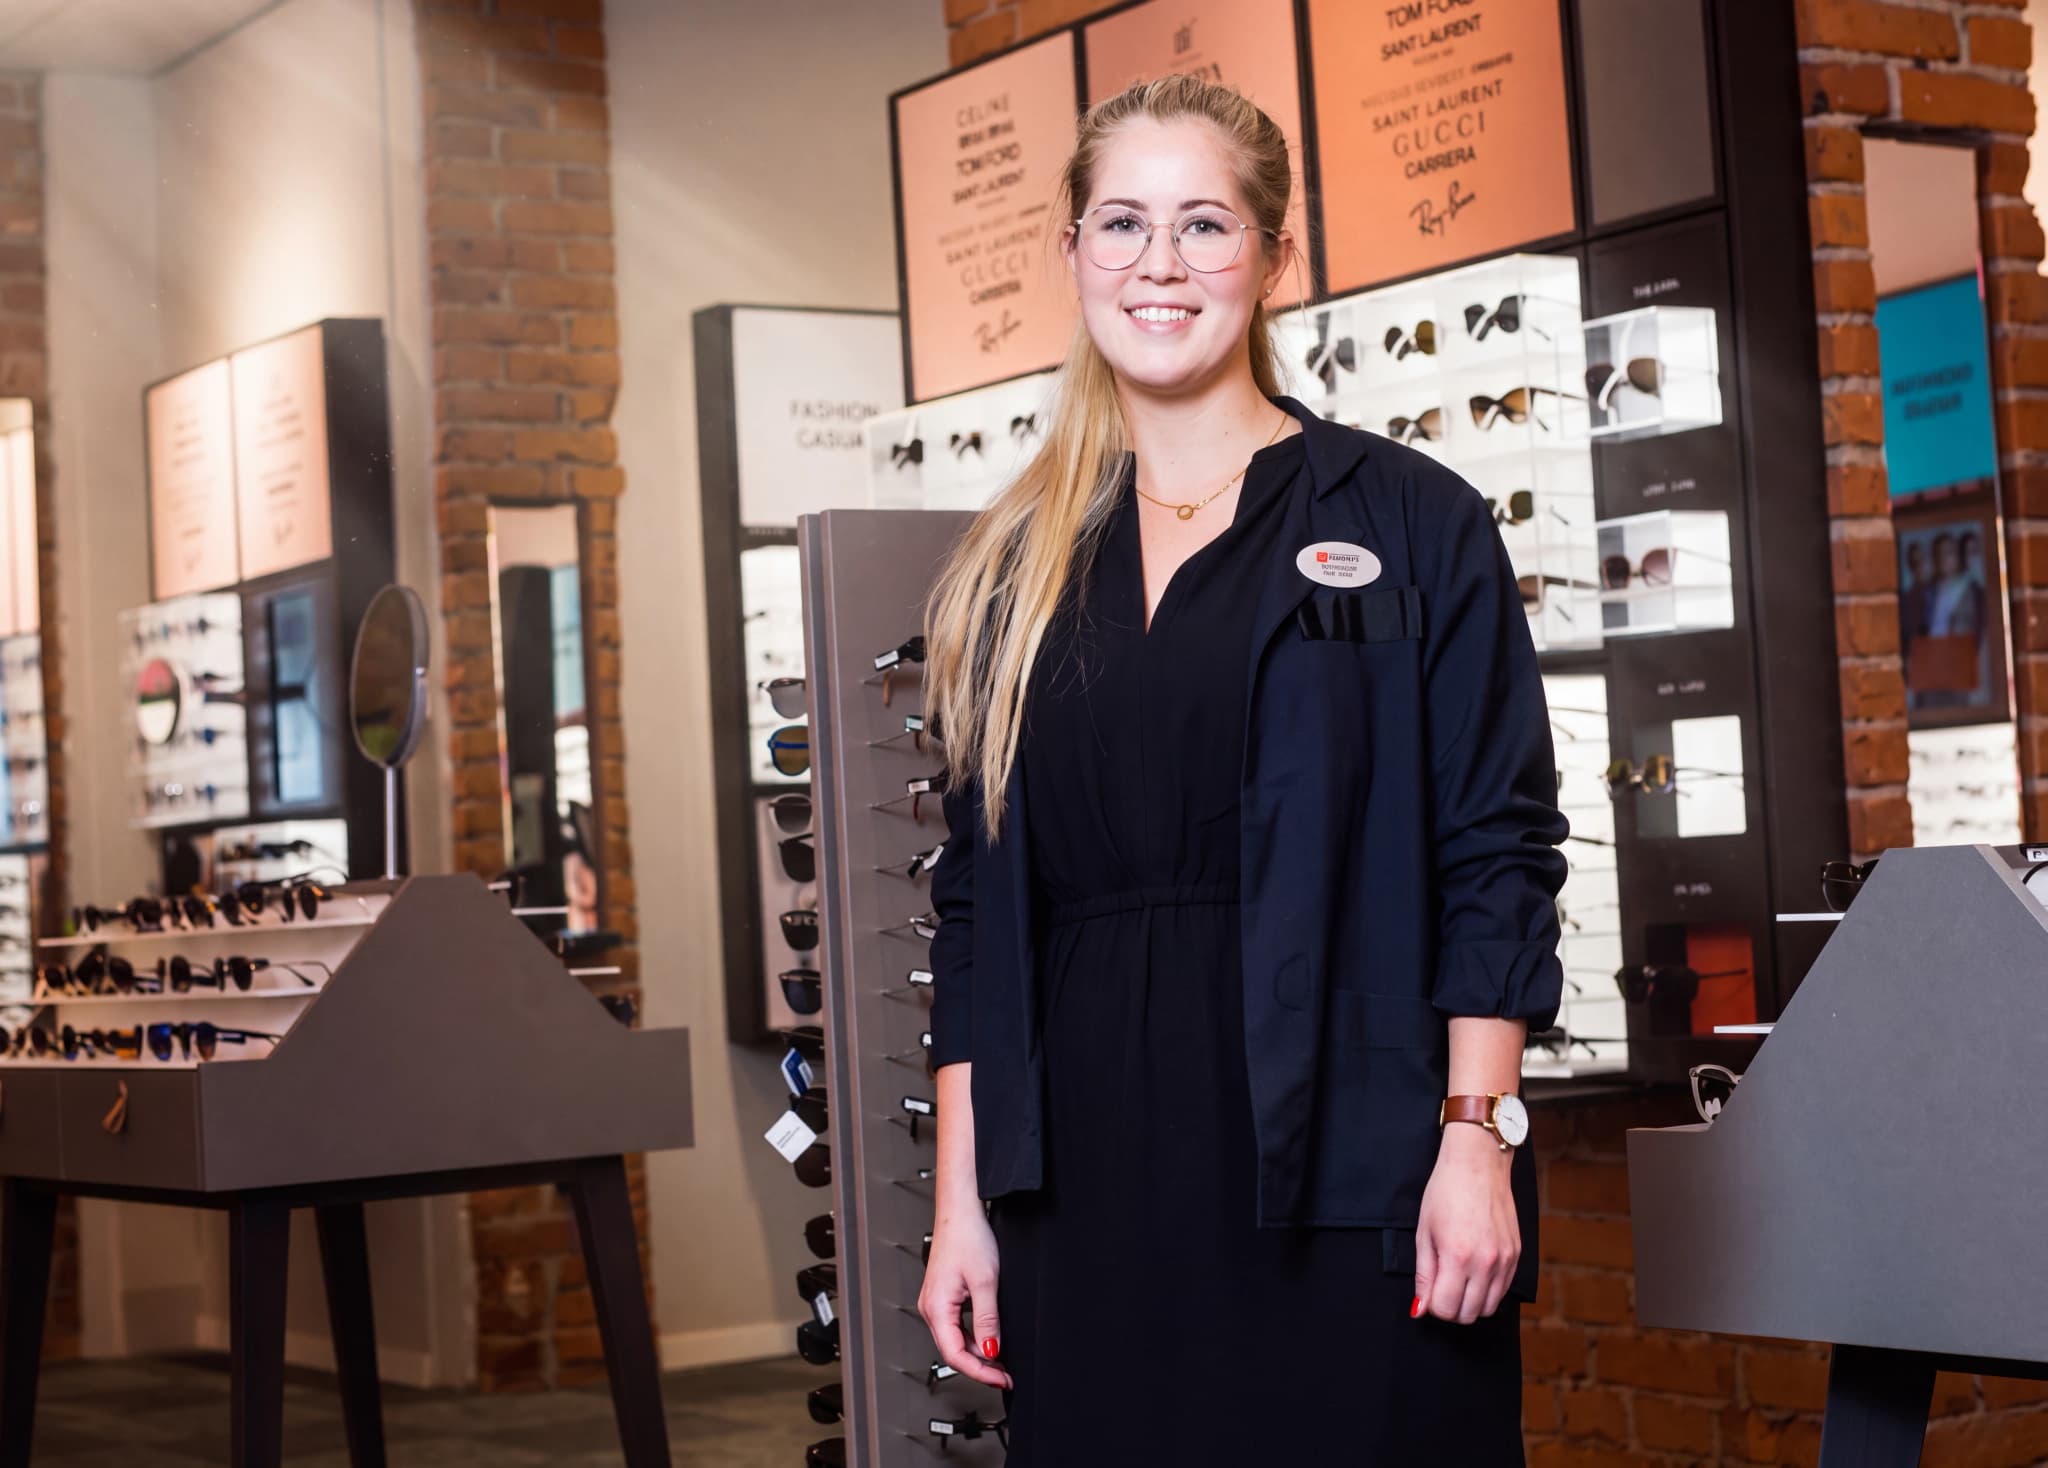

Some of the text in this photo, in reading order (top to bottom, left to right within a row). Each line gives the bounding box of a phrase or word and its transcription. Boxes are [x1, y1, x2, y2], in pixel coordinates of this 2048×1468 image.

[1386, 0, 1475, 30] TOM FO
[1381, 34, 1417, 62] SAINT
[1420, 12, 1482, 48] LAURENT
[1372, 104, 1419, 133] SAINT
[1426, 78, 1503, 117] LAURENT
[1392, 109, 1485, 157] GUCCI
[1404, 144, 1477, 179] CARRERA
[790, 400, 880, 421] FASHION
[796, 427, 863, 449] CASUA
